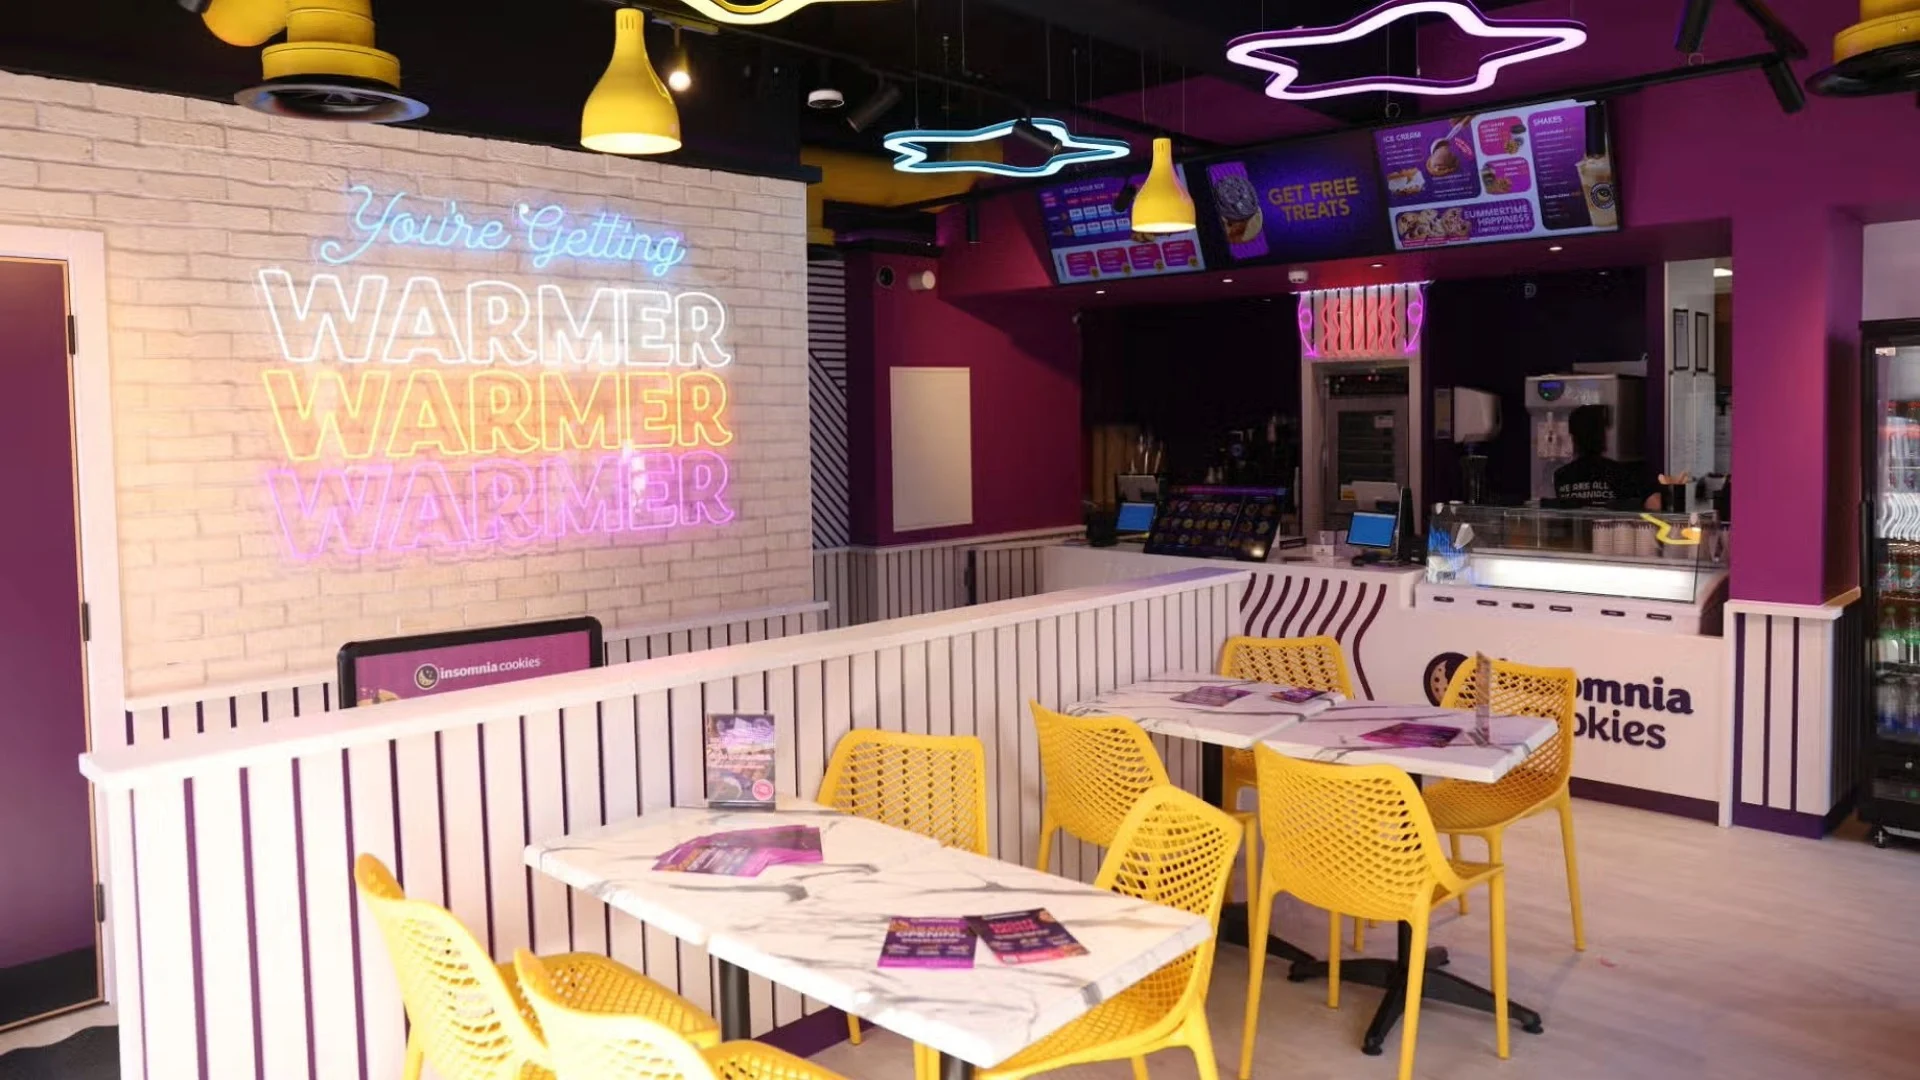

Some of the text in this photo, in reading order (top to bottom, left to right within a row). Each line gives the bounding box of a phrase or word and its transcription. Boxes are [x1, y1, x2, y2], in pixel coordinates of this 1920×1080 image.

[1532, 115, 1563, 126] SHAKES
[1396, 131, 1421, 141] CREAM
[1268, 176, 1360, 206] GET FREE
[1281, 198, 1350, 221] TREATS
[1464, 205, 1527, 219] SUMMERTIME
[1477, 213, 1529, 227] HAPPINESS
[320, 185, 687, 276] You're Getting
[258, 268, 733, 368] WARMER
[261, 369, 734, 462] WARMER
[1592, 481, 1609, 490] ALL
[265, 451, 735, 560] WARMER
[440, 656, 541, 679] insomnia cookies
